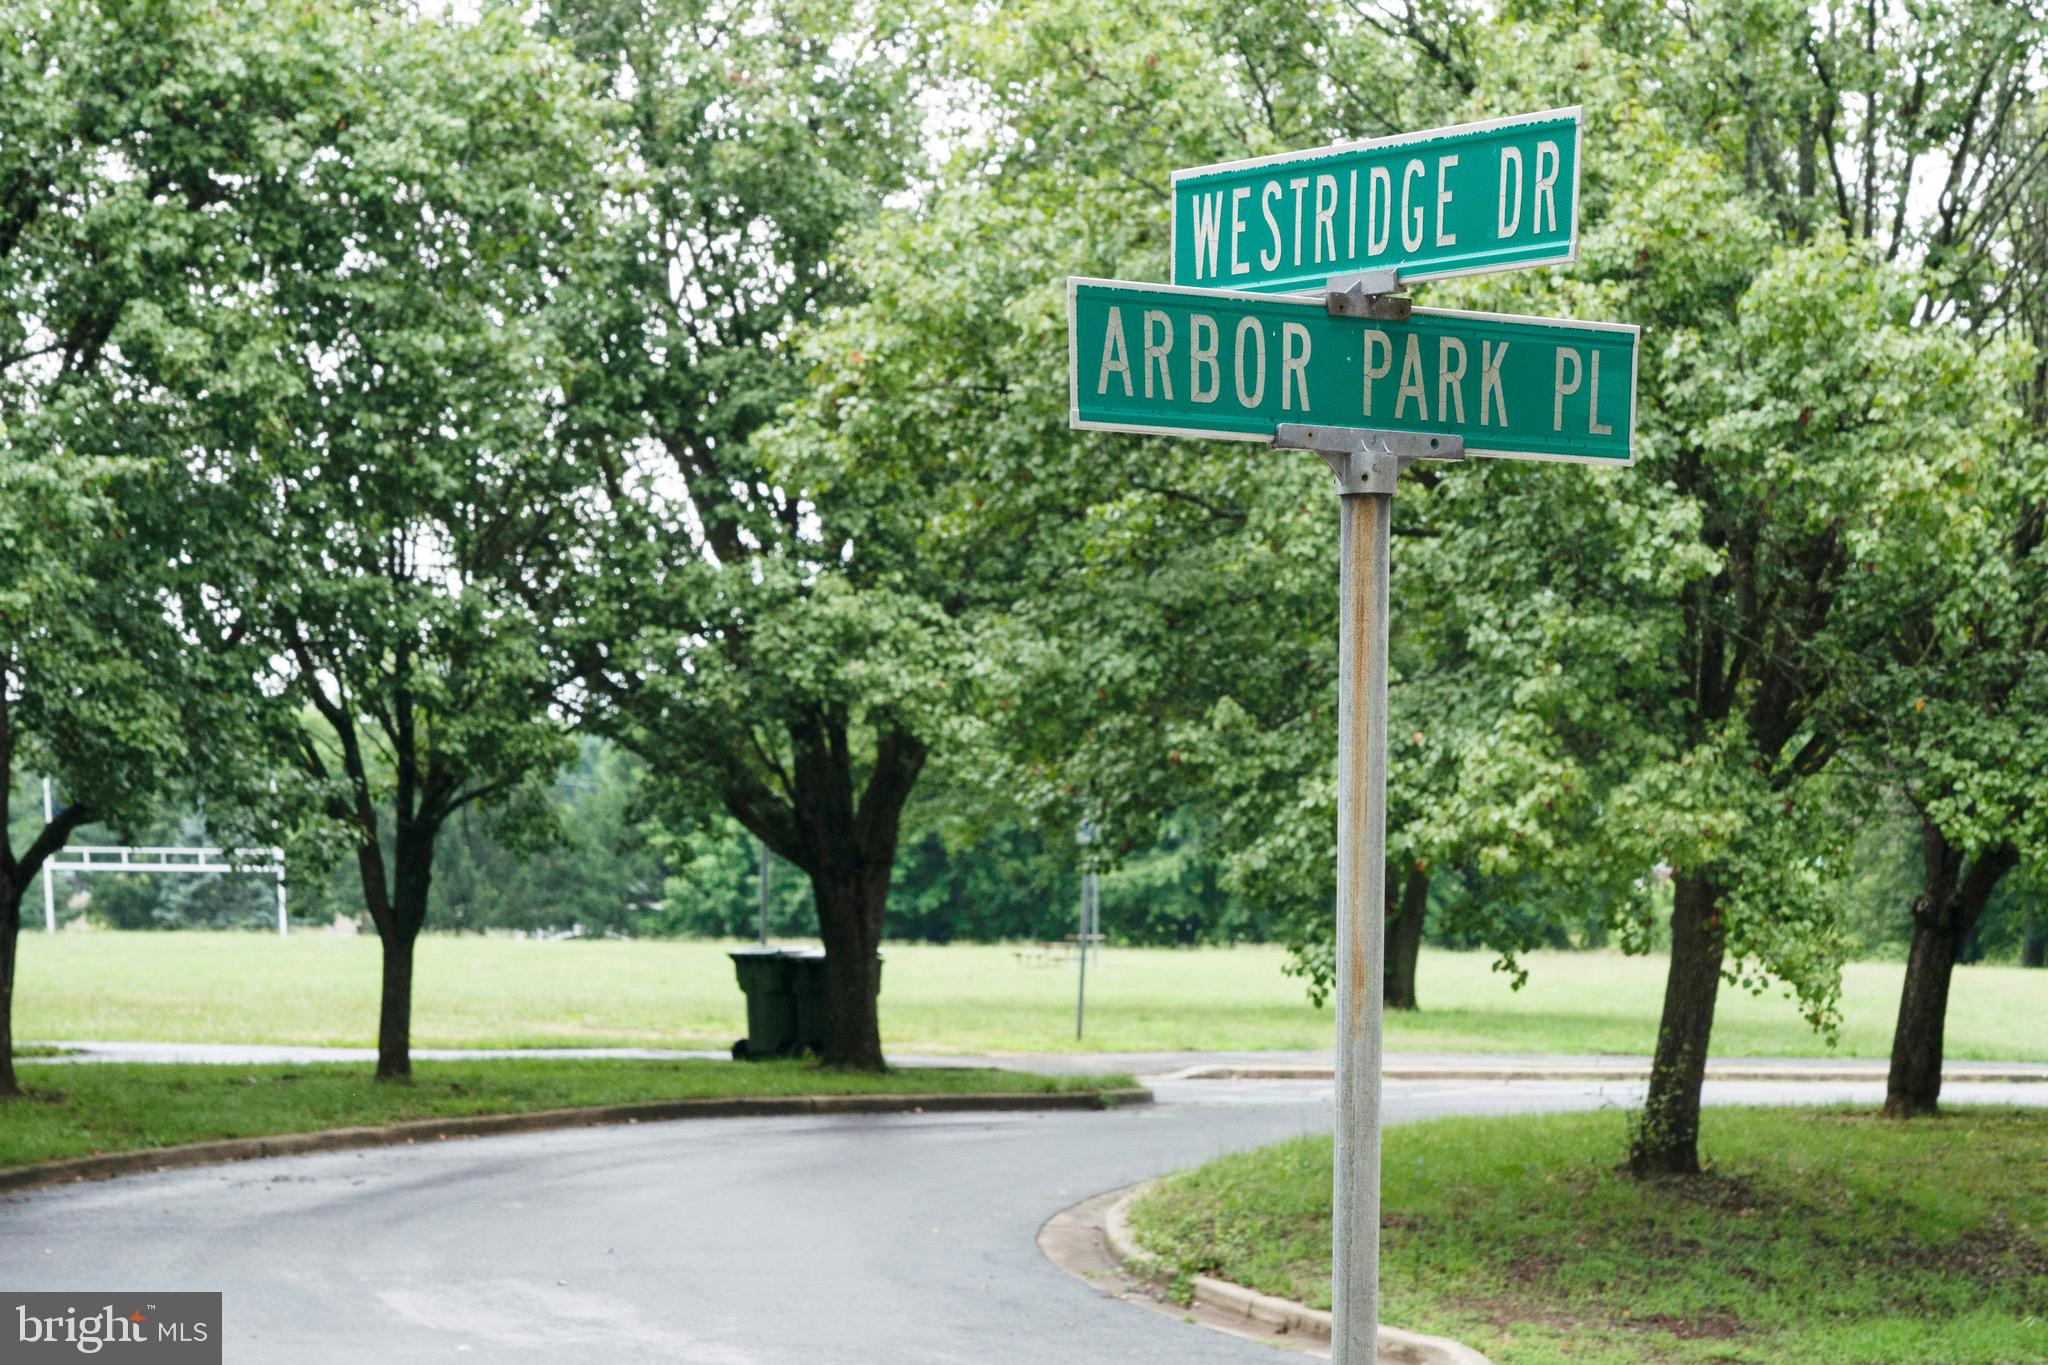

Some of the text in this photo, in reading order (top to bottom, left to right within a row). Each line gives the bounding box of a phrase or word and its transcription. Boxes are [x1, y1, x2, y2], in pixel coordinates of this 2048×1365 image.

[1192, 141, 1560, 280] WESTRIDGE DR
[1098, 306, 1612, 435] ARBOR PARK PL
